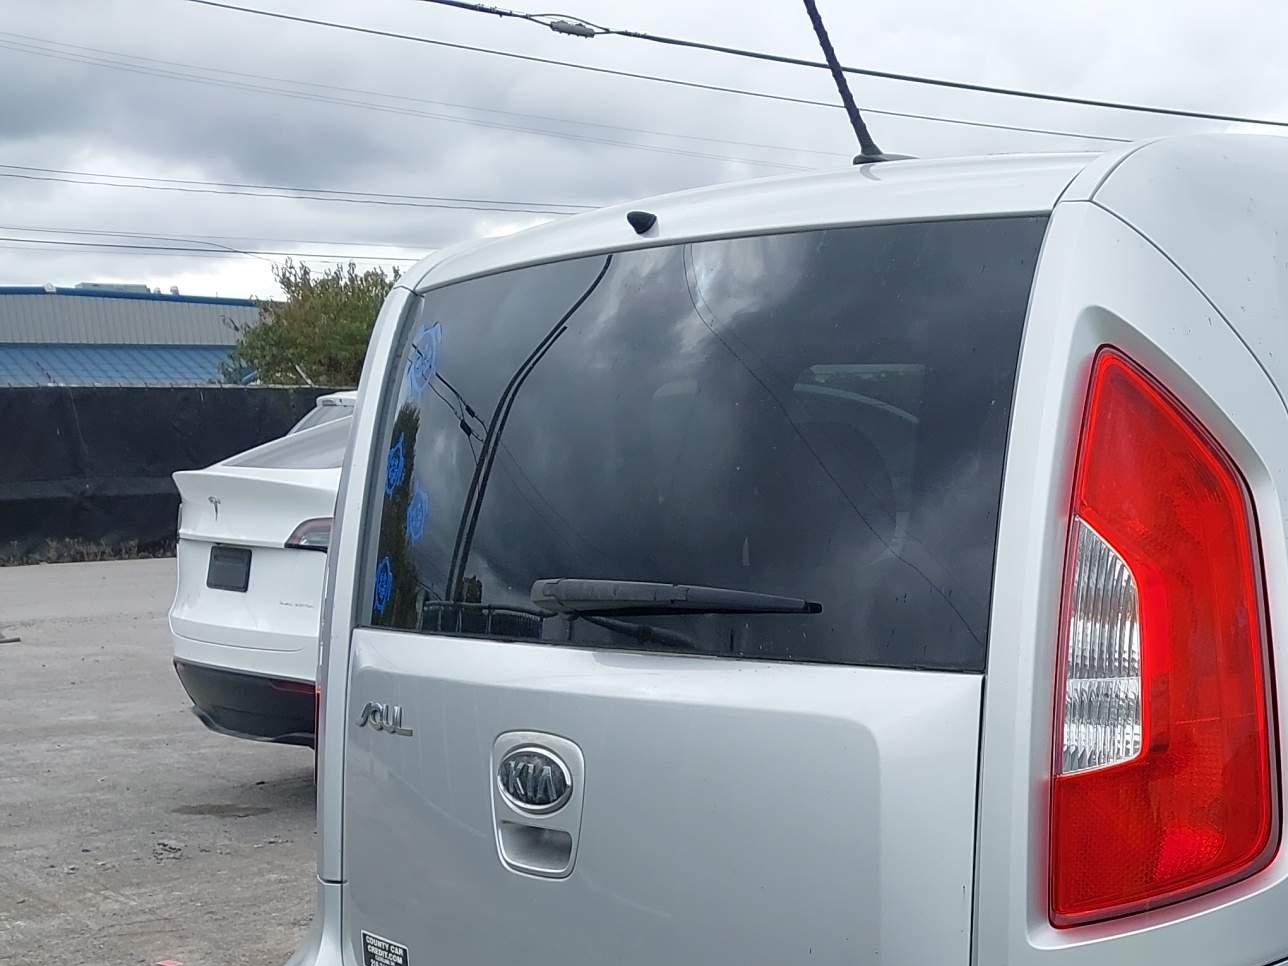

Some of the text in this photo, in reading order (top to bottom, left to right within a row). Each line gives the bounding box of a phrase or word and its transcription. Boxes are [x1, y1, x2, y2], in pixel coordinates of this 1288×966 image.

[508, 760, 558, 800] KIA
[365, 935, 404, 956] COUNTY CAR
